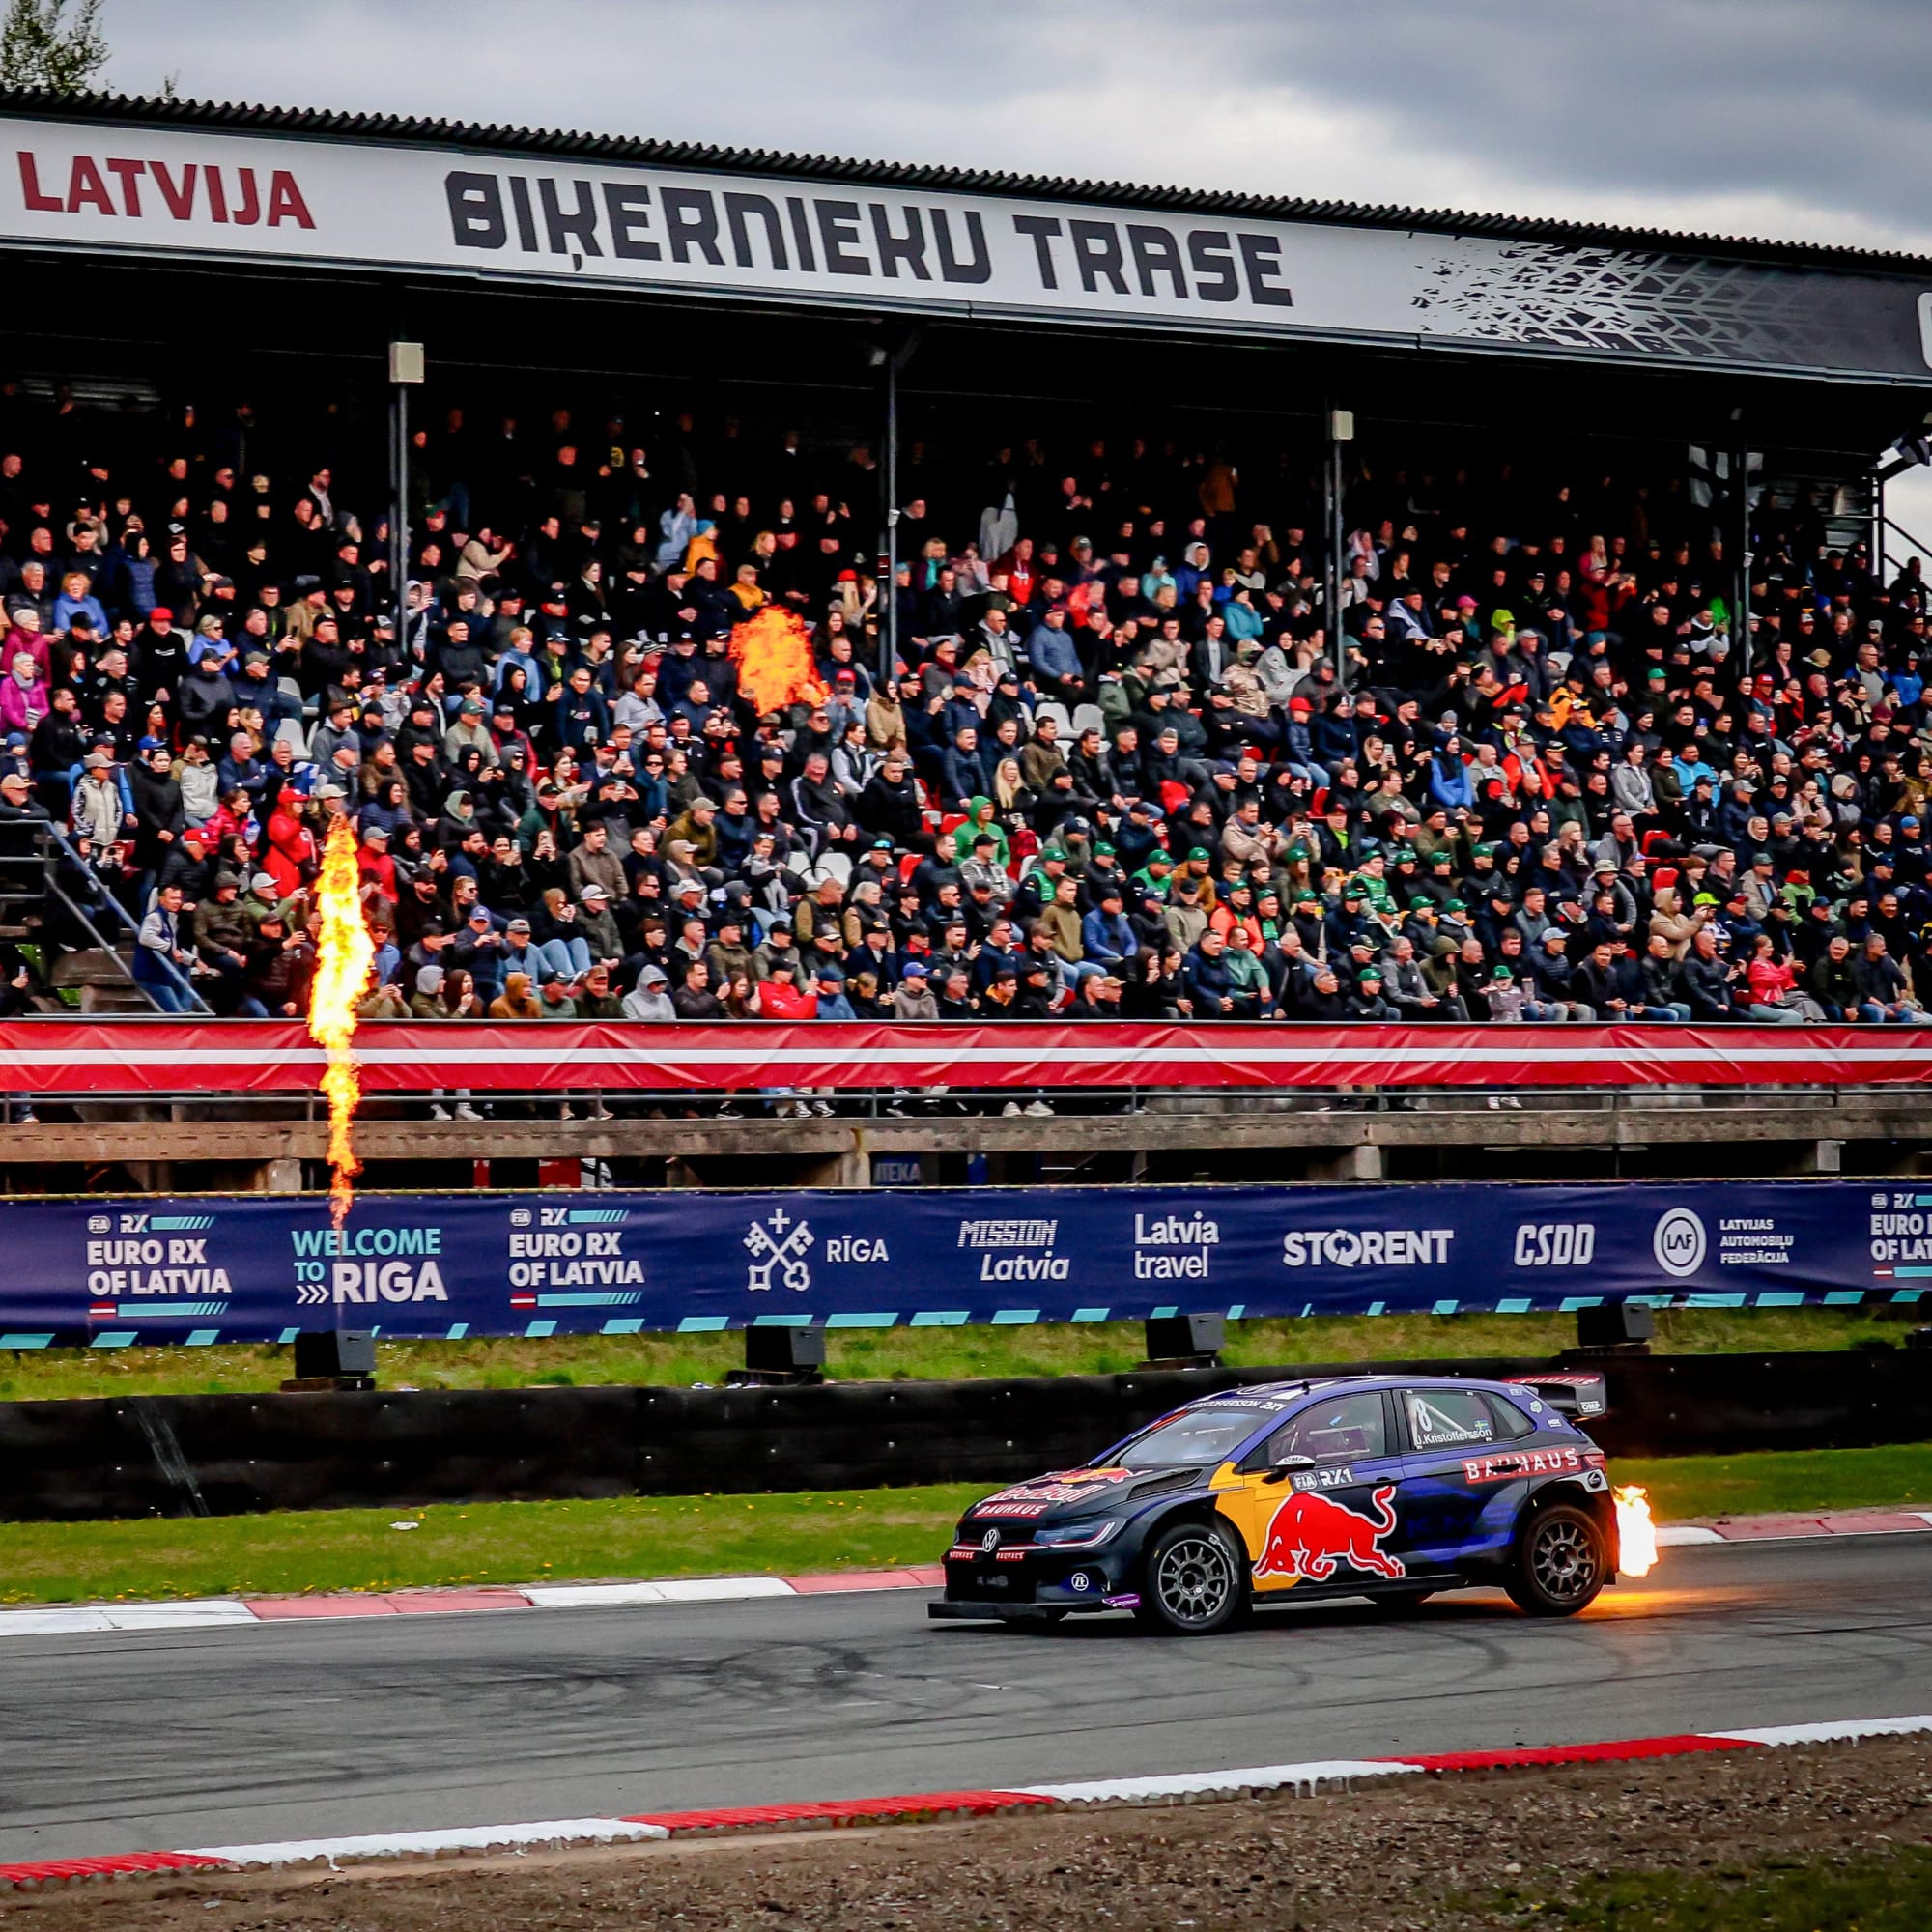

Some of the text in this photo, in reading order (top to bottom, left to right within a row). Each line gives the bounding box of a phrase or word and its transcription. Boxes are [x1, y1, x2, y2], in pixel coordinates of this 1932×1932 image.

[17, 151, 317, 230] LATVIJA
[444, 170, 1293, 307] BIĶERNIEKU TRASE
[120, 1214, 149, 1233] RX
[540, 1208, 568, 1227] RX
[1134, 1210, 1219, 1244] Latvia
[1719, 1219, 1774, 1231] LATVIJAS
[1870, 1214, 1924, 1236] EURO
[291, 1229, 441, 1257] WELCOME
[509, 1232, 622, 1258] EURO RX
[957, 1220, 1058, 1247] MISSION
[1282, 1228, 1454, 1267] STORENT
[1514, 1224, 1595, 1266] CSDD
[87, 1239, 207, 1265] EURO RX
[826, 1235, 889, 1263] RĪGA
[1134, 1245, 1208, 1278] travel
[1870, 1239, 1898, 1261] OF
[509, 1260, 645, 1288] OF LATVIA
[980, 1250, 1069, 1281] Latvia
[88, 1269, 233, 1296] OF LATVIA
[294, 1261, 448, 1304] TO RIGA
[1294, 1467, 1353, 1489] FIA RX1
[1464, 1448, 1578, 1480] BAUHAUS
[976, 1504, 1049, 1516] BAUHAUS
